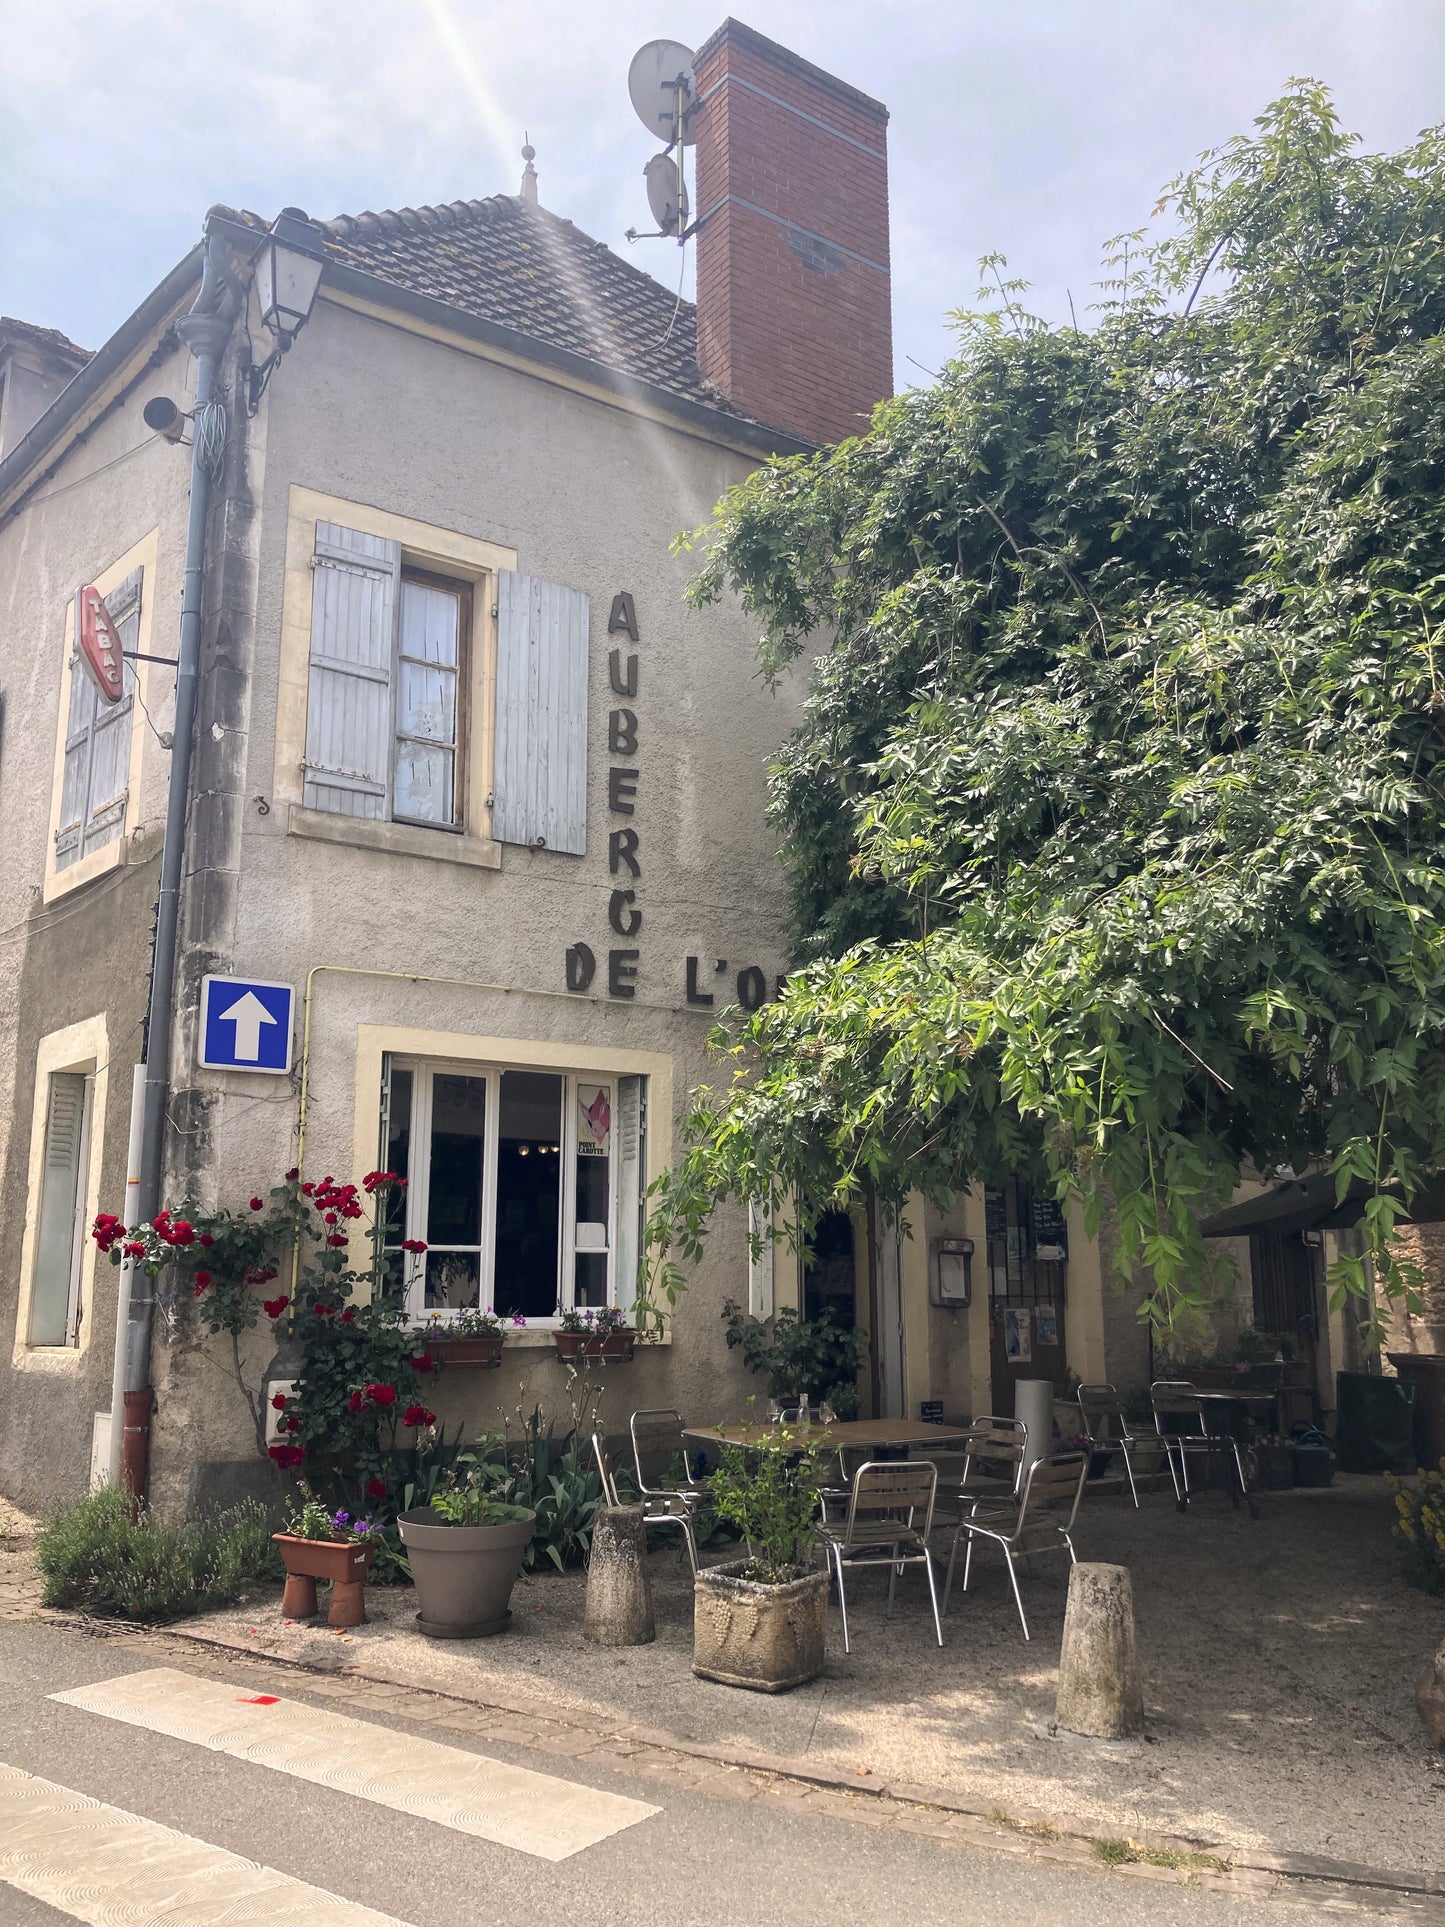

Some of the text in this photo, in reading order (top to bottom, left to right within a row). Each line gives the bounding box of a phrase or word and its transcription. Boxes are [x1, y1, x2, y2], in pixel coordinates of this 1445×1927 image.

[88, 599, 120, 683] TABAC
[608, 591, 641, 997] AUBERGE
[565, 942, 640, 997] DE
